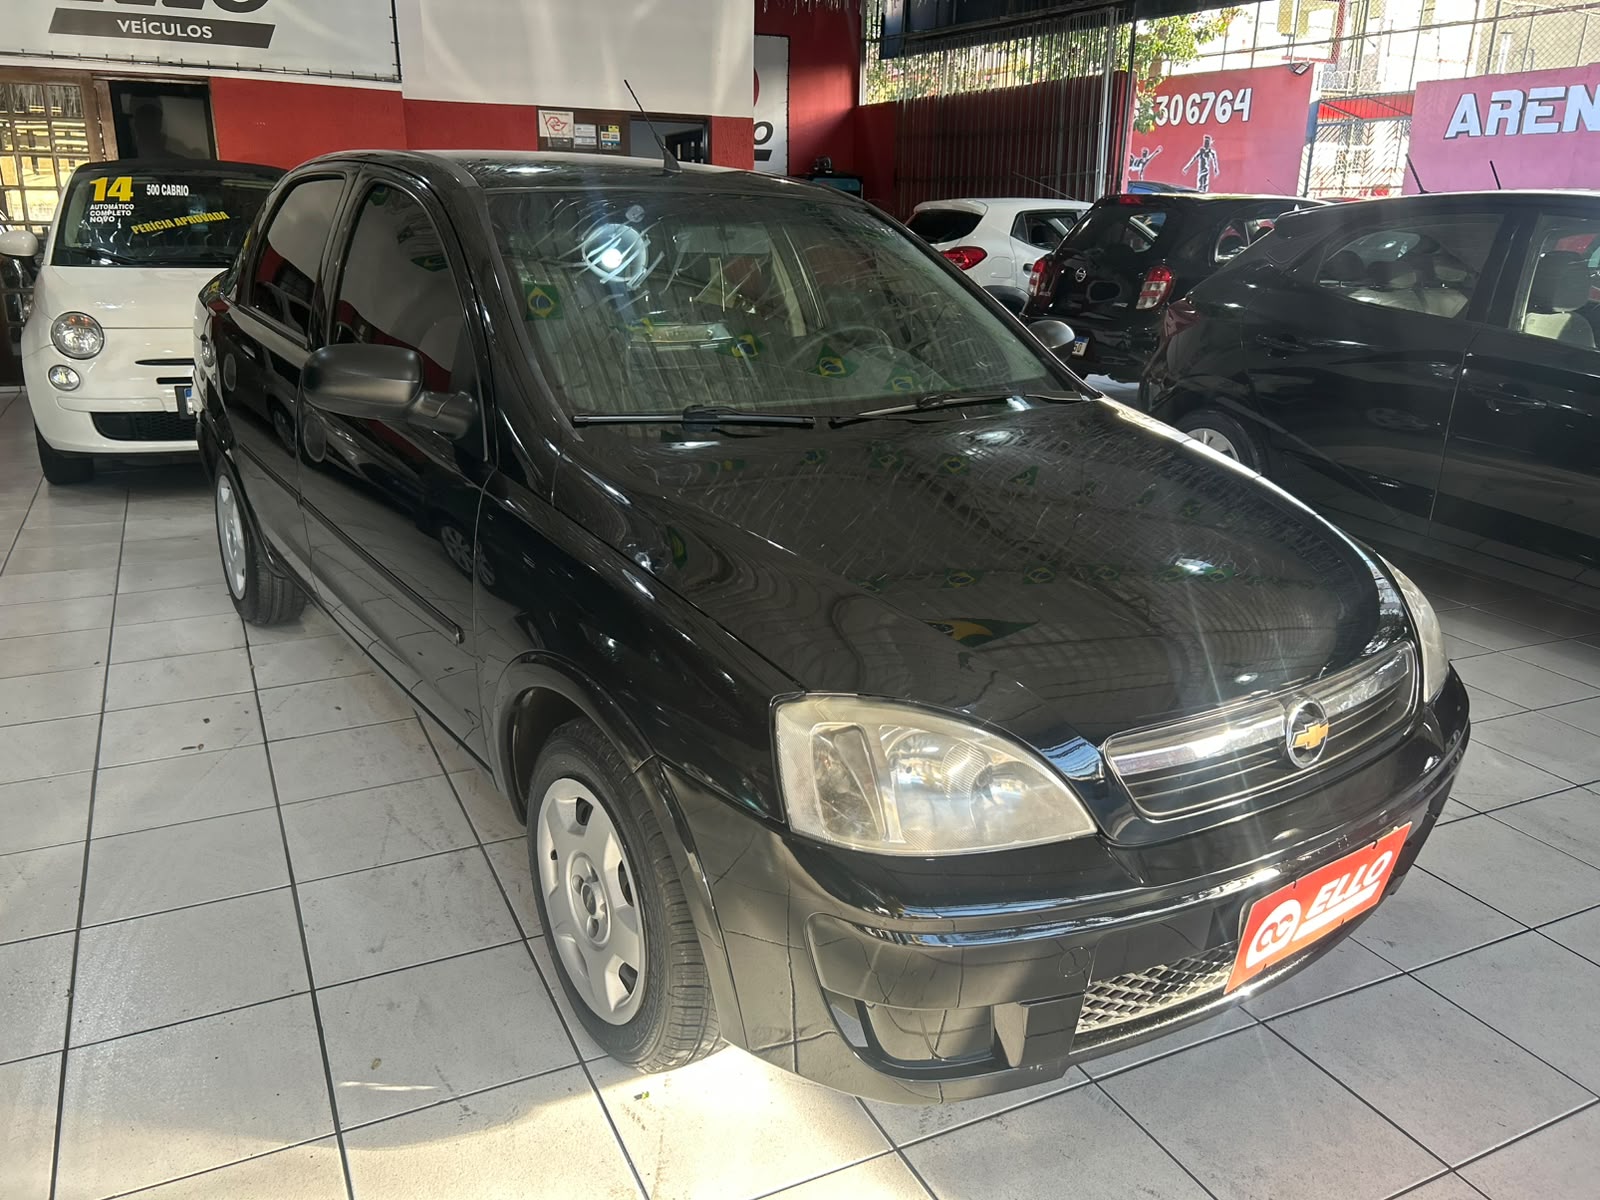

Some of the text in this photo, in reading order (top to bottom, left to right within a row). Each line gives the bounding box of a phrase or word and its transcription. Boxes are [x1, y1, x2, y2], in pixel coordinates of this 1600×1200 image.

[116, 18, 213, 39] VEÍCULOS
[1134, 87, 1253, 126] 306764
[90, 176, 134, 202] 14
[146, 184, 189, 197] 500 CABRIO
[90, 202, 135, 211] AUTOMÁTICO
[130, 210, 230, 235] PERÍCIA APROVADA
[1305, 850, 1393, 919] ELLO
